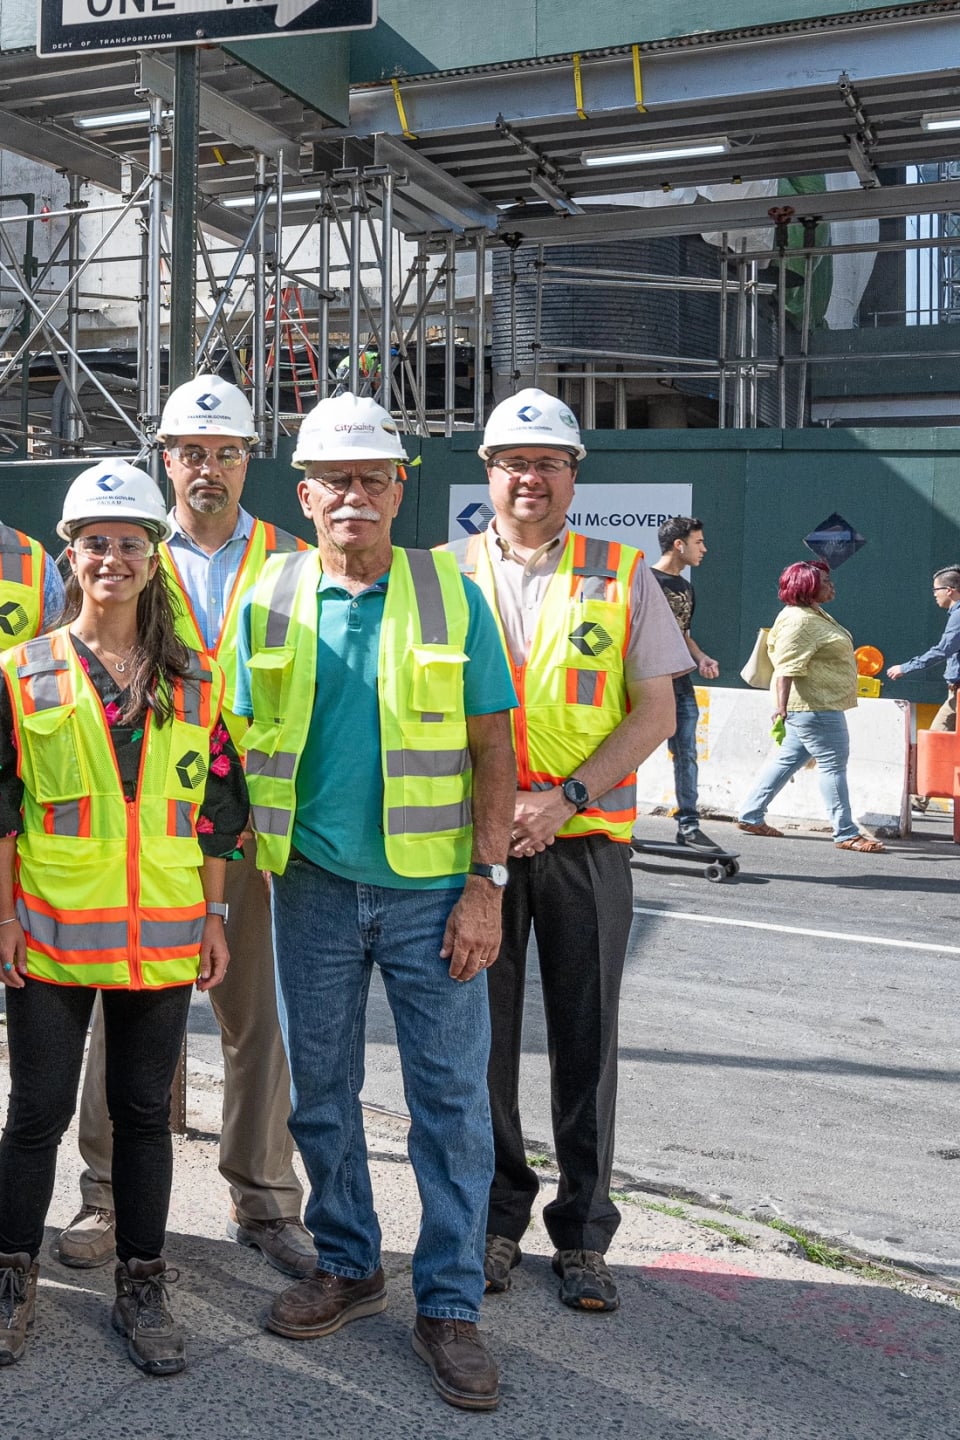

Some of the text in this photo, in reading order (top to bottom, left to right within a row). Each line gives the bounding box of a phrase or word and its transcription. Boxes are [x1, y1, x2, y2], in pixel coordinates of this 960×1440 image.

[52, 42, 72, 50] DEPT
[100, 33, 172, 46] TRANSPORTATION
[585, 513, 681, 527] McGOVER
